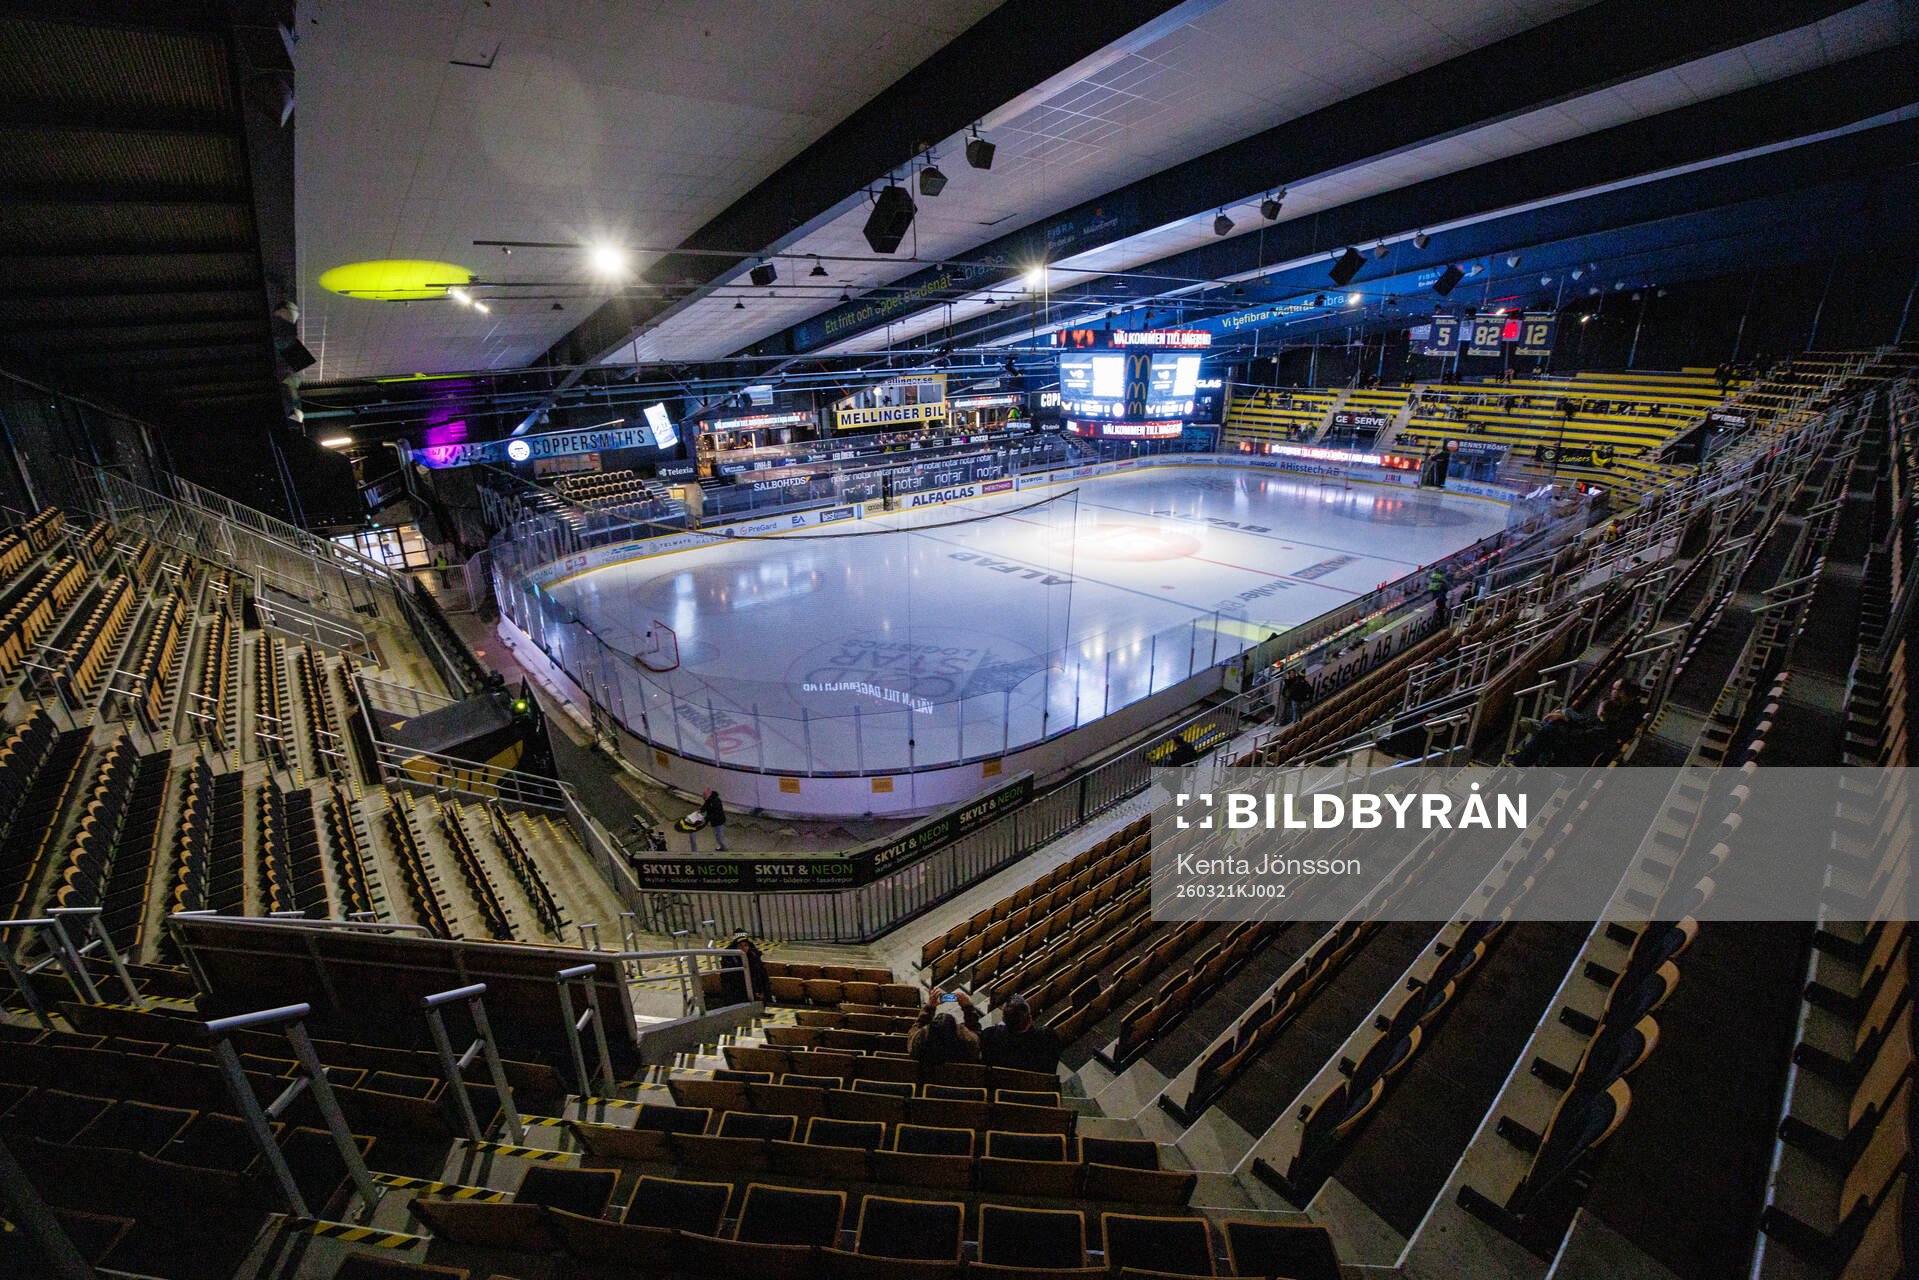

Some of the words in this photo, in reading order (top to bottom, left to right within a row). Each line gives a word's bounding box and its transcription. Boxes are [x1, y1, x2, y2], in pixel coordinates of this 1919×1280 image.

[825, 319, 837, 334] Ett
[838, 311, 855, 328] fritt
[857, 306, 873, 321] och
[1222, 317, 1231, 328] Vi
[1233, 310, 1270, 325] befibrar
[1437, 327, 1451, 346] 5
[1474, 326, 1500, 346] 82
[1525, 325, 1549, 345] 12
[841, 408, 919, 425] MELLINGER
[925, 406, 944, 418] BIL
[532, 430, 645, 456] COPPERSMITH'S
[667, 466, 693, 476] Telexia
[924, 461, 941, 470] notar
[942, 459, 958, 468] notar
[959, 457, 975, 465] notar
[1286, 463, 1323, 476] Hisstech
[754, 476, 806, 492] SALBOHEDS
[893, 476, 924, 491] notar
[934, 470, 963, 485] notar
[912, 486, 974, 507] ALFAGLAS
[748, 522, 777, 534] PreGard
[1370, 635, 1393, 665] AB
[959, 803, 988, 825] SKYLT
[989, 799, 996, 810] &
[998, 786, 1024, 806] NEON
[874, 842, 907, 865] SKYLT
[909, 838, 917, 849] &
[919, 821, 949, 843] NEON
[642, 864, 681, 876] SKYLT
[685, 864, 694, 876] &
[698, 865, 739, 876] NEON
[754, 864, 795, 876] SKYLT
[798, 864, 808, 876] &
[811, 864, 853, 875] NEON
